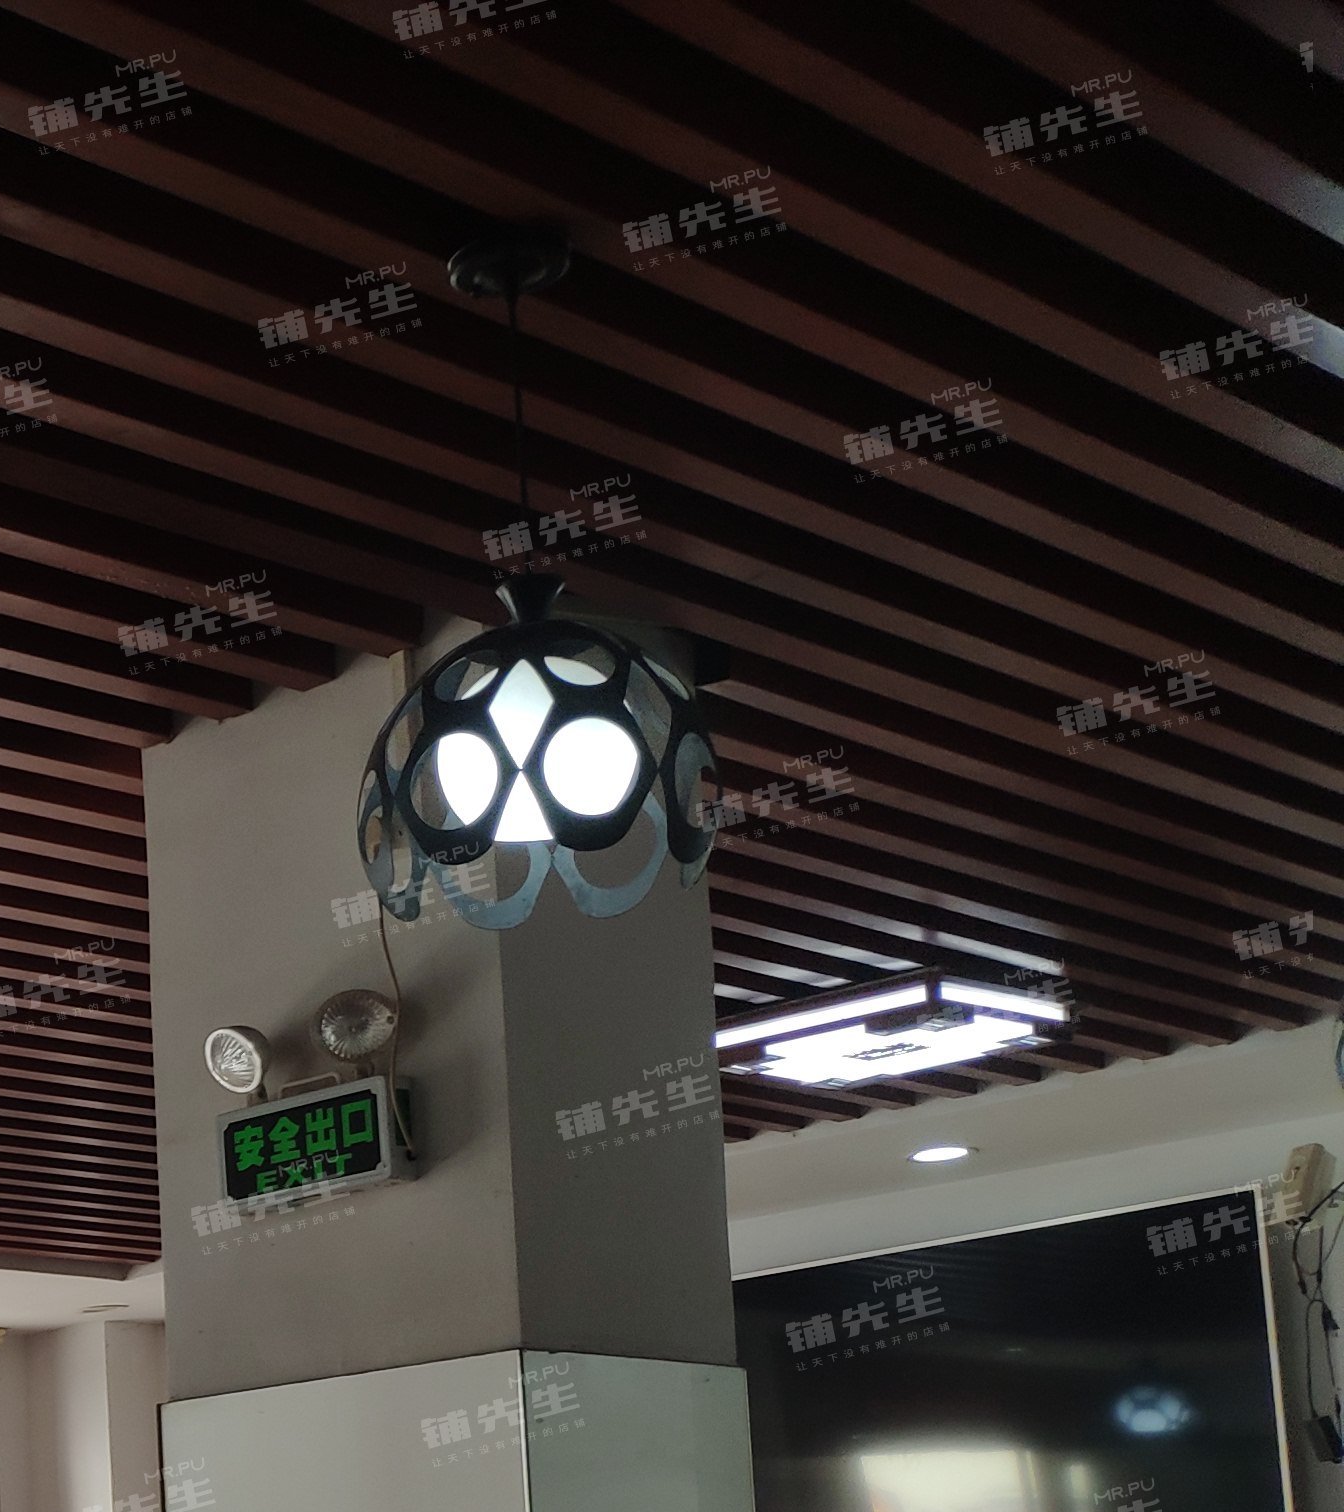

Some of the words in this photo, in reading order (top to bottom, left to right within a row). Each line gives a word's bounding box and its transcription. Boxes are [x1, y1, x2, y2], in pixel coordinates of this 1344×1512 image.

[233, 1099, 374, 1172] 安全出口
[256, 1153, 353, 1193] EXIT
